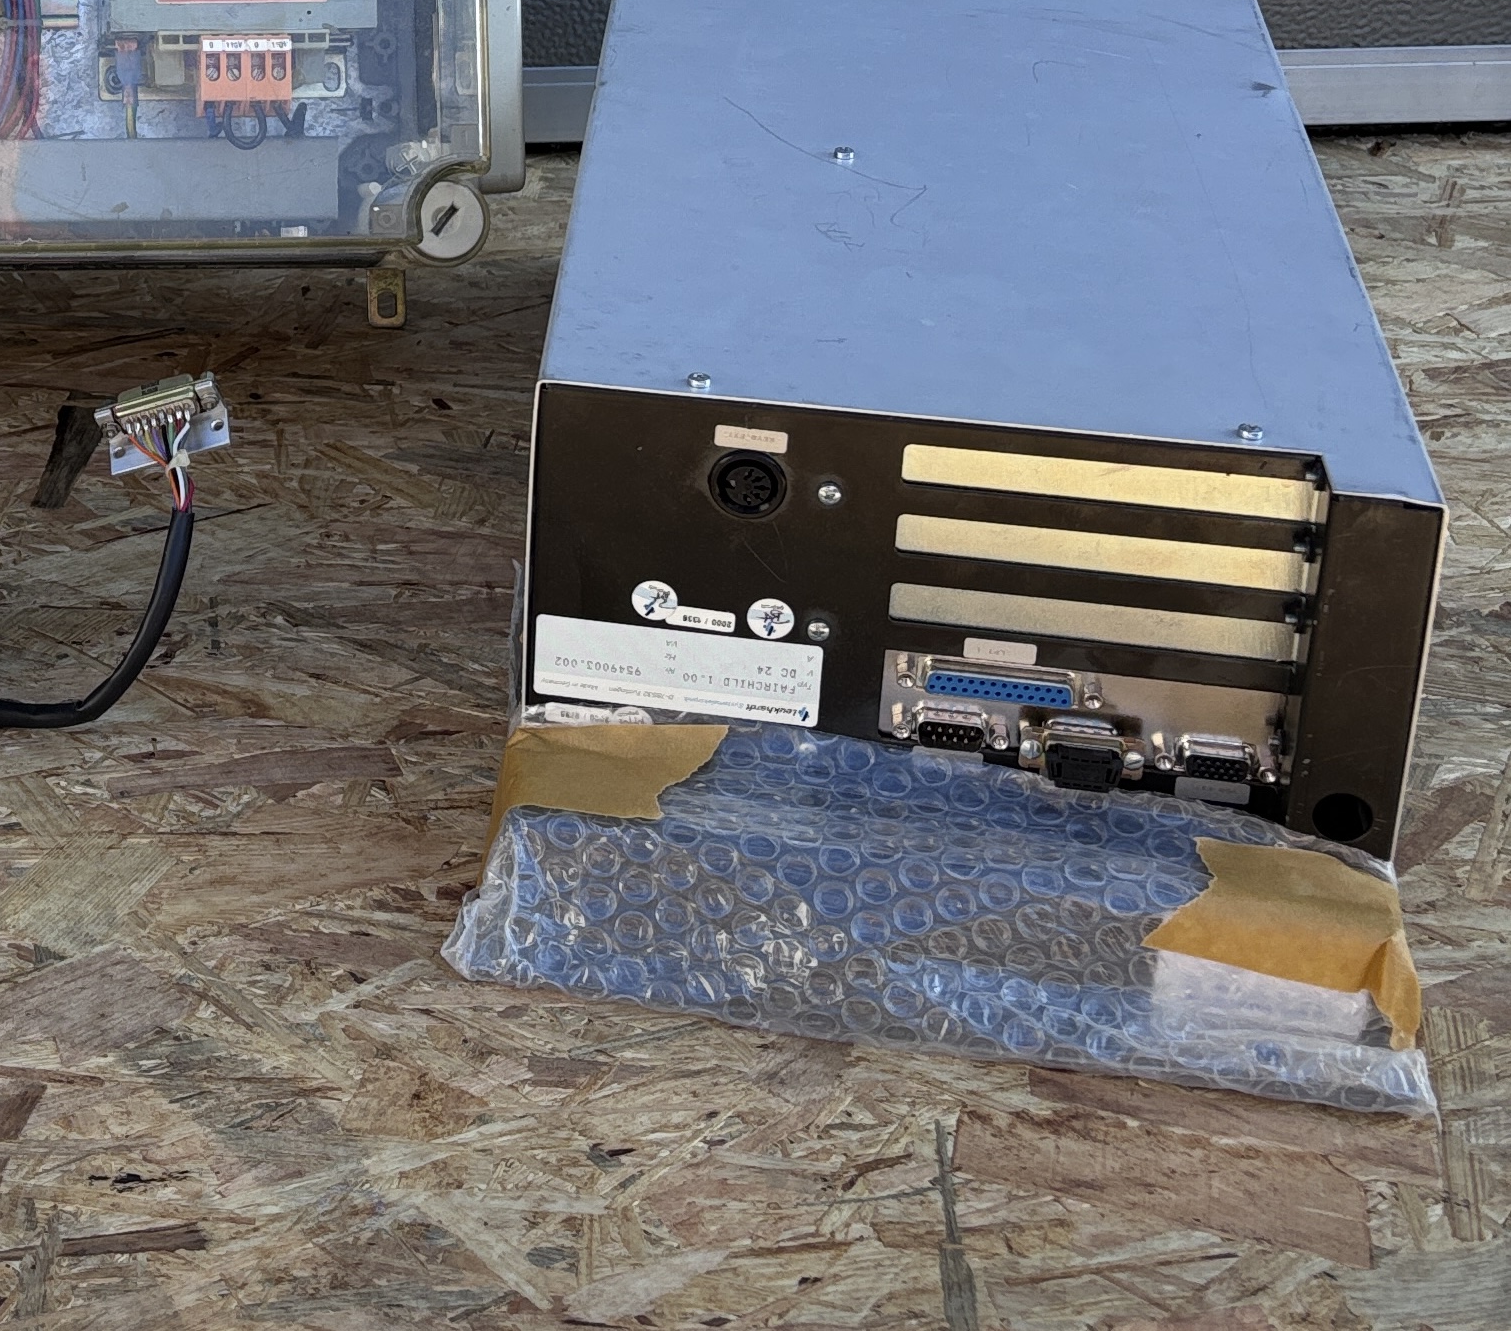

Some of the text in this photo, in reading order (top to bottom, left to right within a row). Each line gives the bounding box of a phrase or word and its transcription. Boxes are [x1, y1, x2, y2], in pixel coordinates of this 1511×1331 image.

[806, 655, 815, 663] A
[554, 656, 642, 677] 9549003.002
[756, 665, 772, 676] 24
[682, 672, 713, 685] 1.00
[780, 667, 797, 679] DC
[806, 669, 814, 677] V
[723, 677, 796, 695] FAIRCHILD
[796, 681, 813, 691] Typ
[745, 703, 798, 717] Leukhardt
